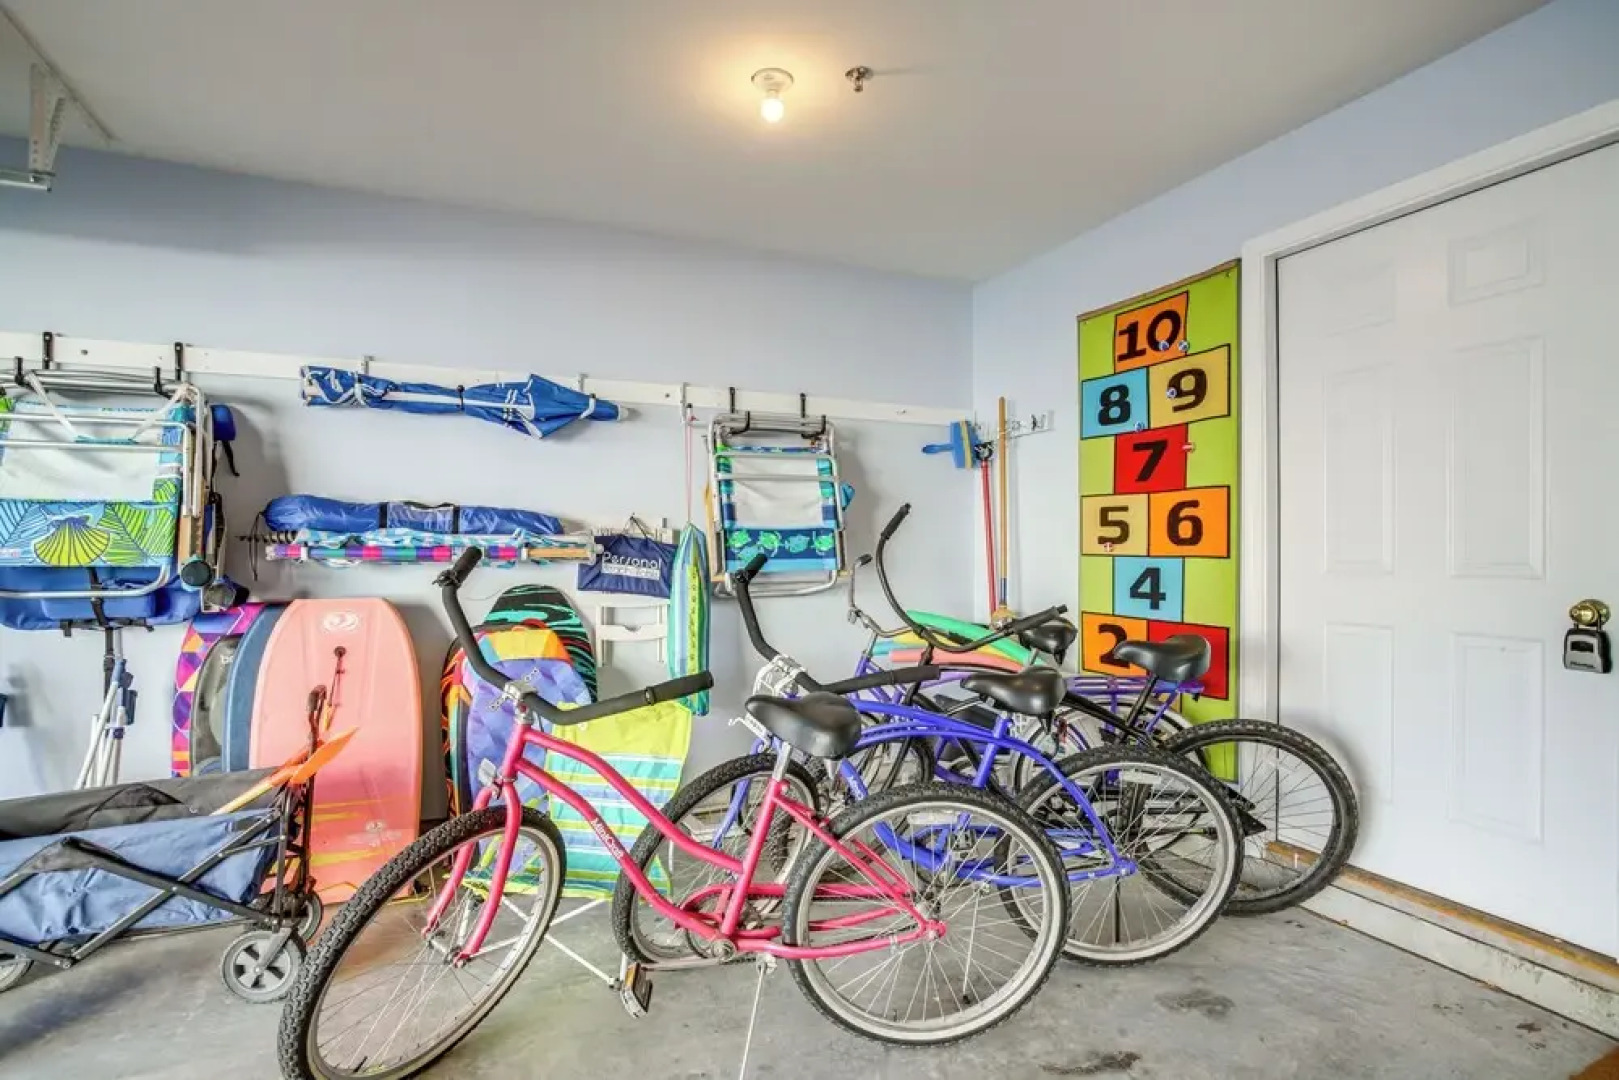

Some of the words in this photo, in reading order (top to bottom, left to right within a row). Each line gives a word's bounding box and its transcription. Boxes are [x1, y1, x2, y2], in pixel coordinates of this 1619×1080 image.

[1117, 309, 1182, 363] 10
[1098, 384, 1131, 426] 8
[1167, 368, 1208, 412] 9
[1132, 439, 1168, 482] 7
[1097, 505, 1130, 545] 5
[1167, 500, 1203, 546] 6
[602, 551, 662, 570] Personal
[1130, 567, 1166, 610] 4
[1098, 623, 1131, 669] 2
